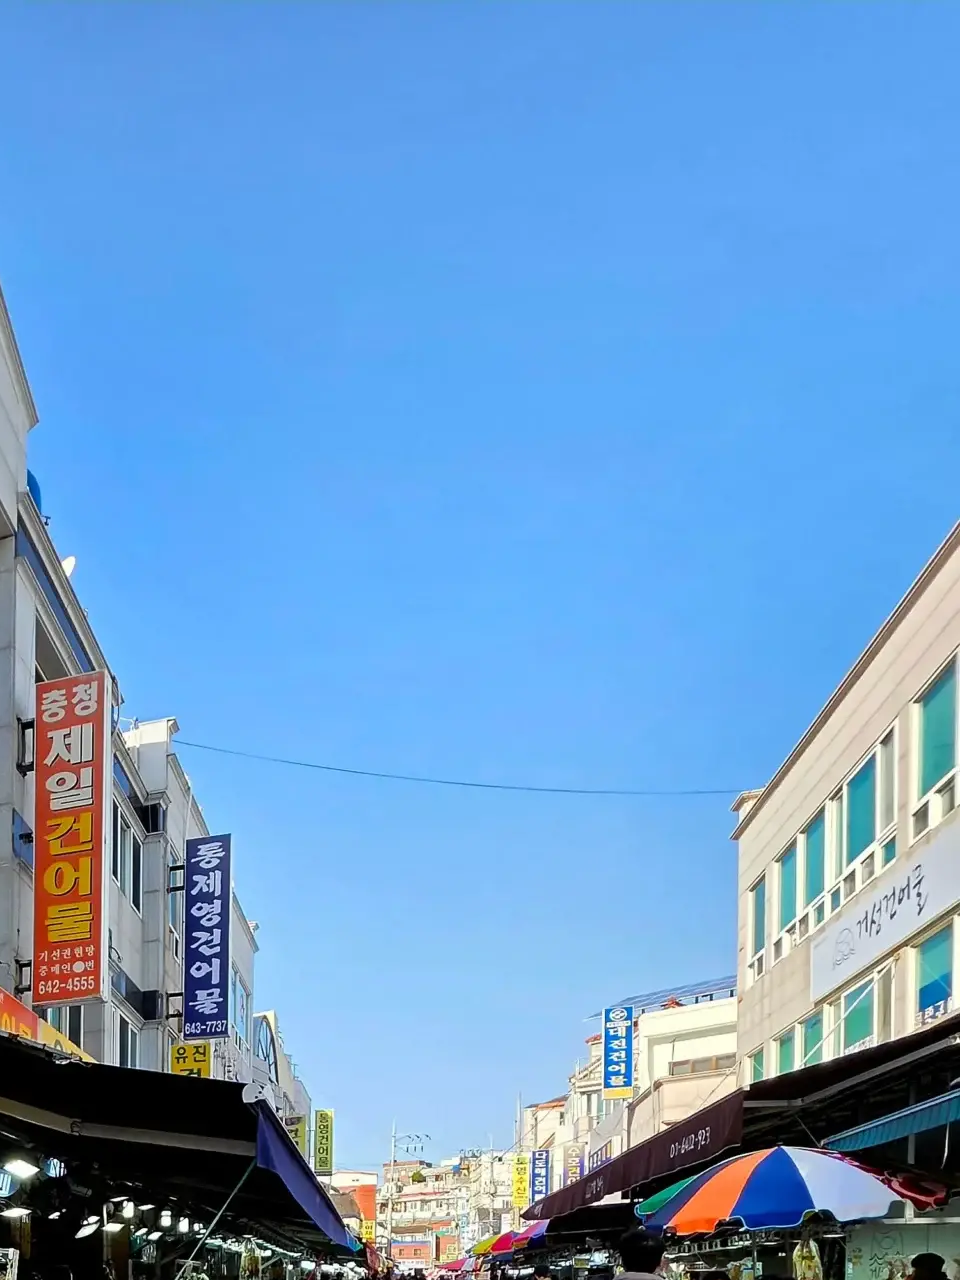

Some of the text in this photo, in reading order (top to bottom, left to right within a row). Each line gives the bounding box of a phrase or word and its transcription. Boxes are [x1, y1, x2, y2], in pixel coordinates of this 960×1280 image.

[41, 681, 99, 724] 충청
[43, 722, 95, 944] 제일건어물
[856, 864, 929, 938] 거성건어물
[189, 841, 227, 1015] 통제영건어물
[38, 976, 95, 994] 642-4555
[185, 1020, 227, 1034] 643-7737
[175, 1045, 207, 1065] 유진
